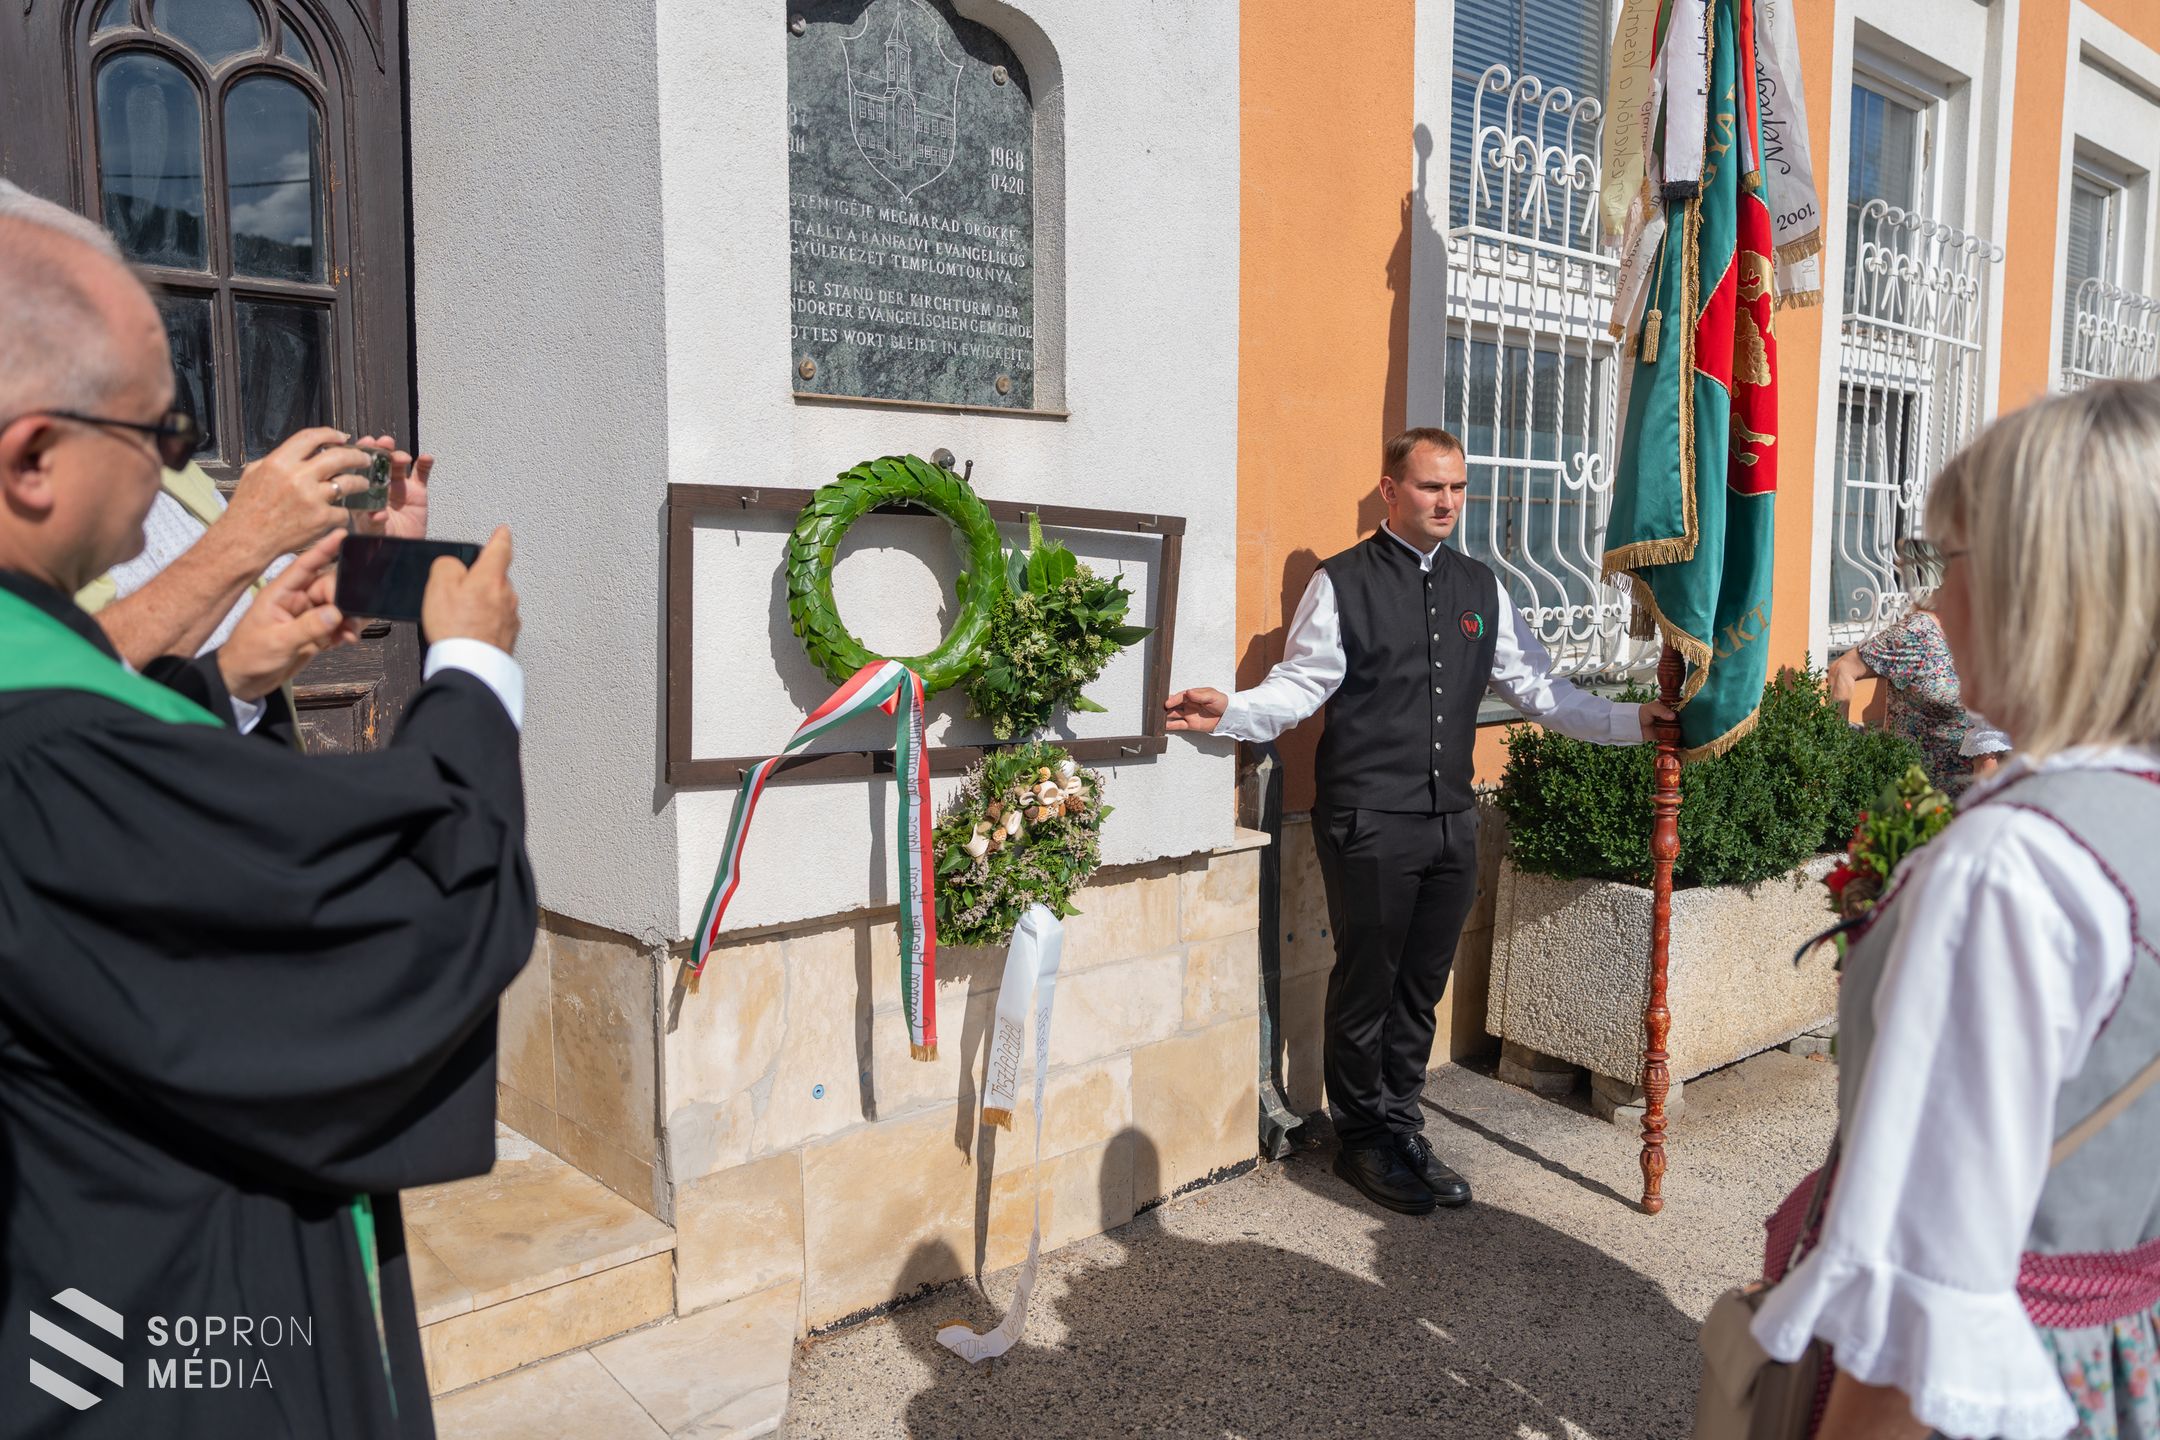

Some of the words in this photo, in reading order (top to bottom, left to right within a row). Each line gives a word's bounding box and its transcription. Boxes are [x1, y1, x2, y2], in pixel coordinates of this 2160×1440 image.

[991, 145, 1024, 172] 1968
[879, 207, 960, 233] MEGMARAD
[1776, 203, 1815, 232] 2001.
[846, 228, 857, 242] A
[861, 228, 928, 253] BÁNFALVI
[936, 241, 1025, 268] EVANGÉLIKUS
[823, 282, 873, 302] STAND
[878, 289, 905, 306] DER
[909, 293, 992, 317] KIRCHTURM
[996, 304, 1020, 320] DER
[857, 305, 968, 331] EVANGELISCHEN
[842, 329, 886, 348] WORT
[890, 335, 938, 353] BLEIBT
[942, 340, 957, 355] IN
